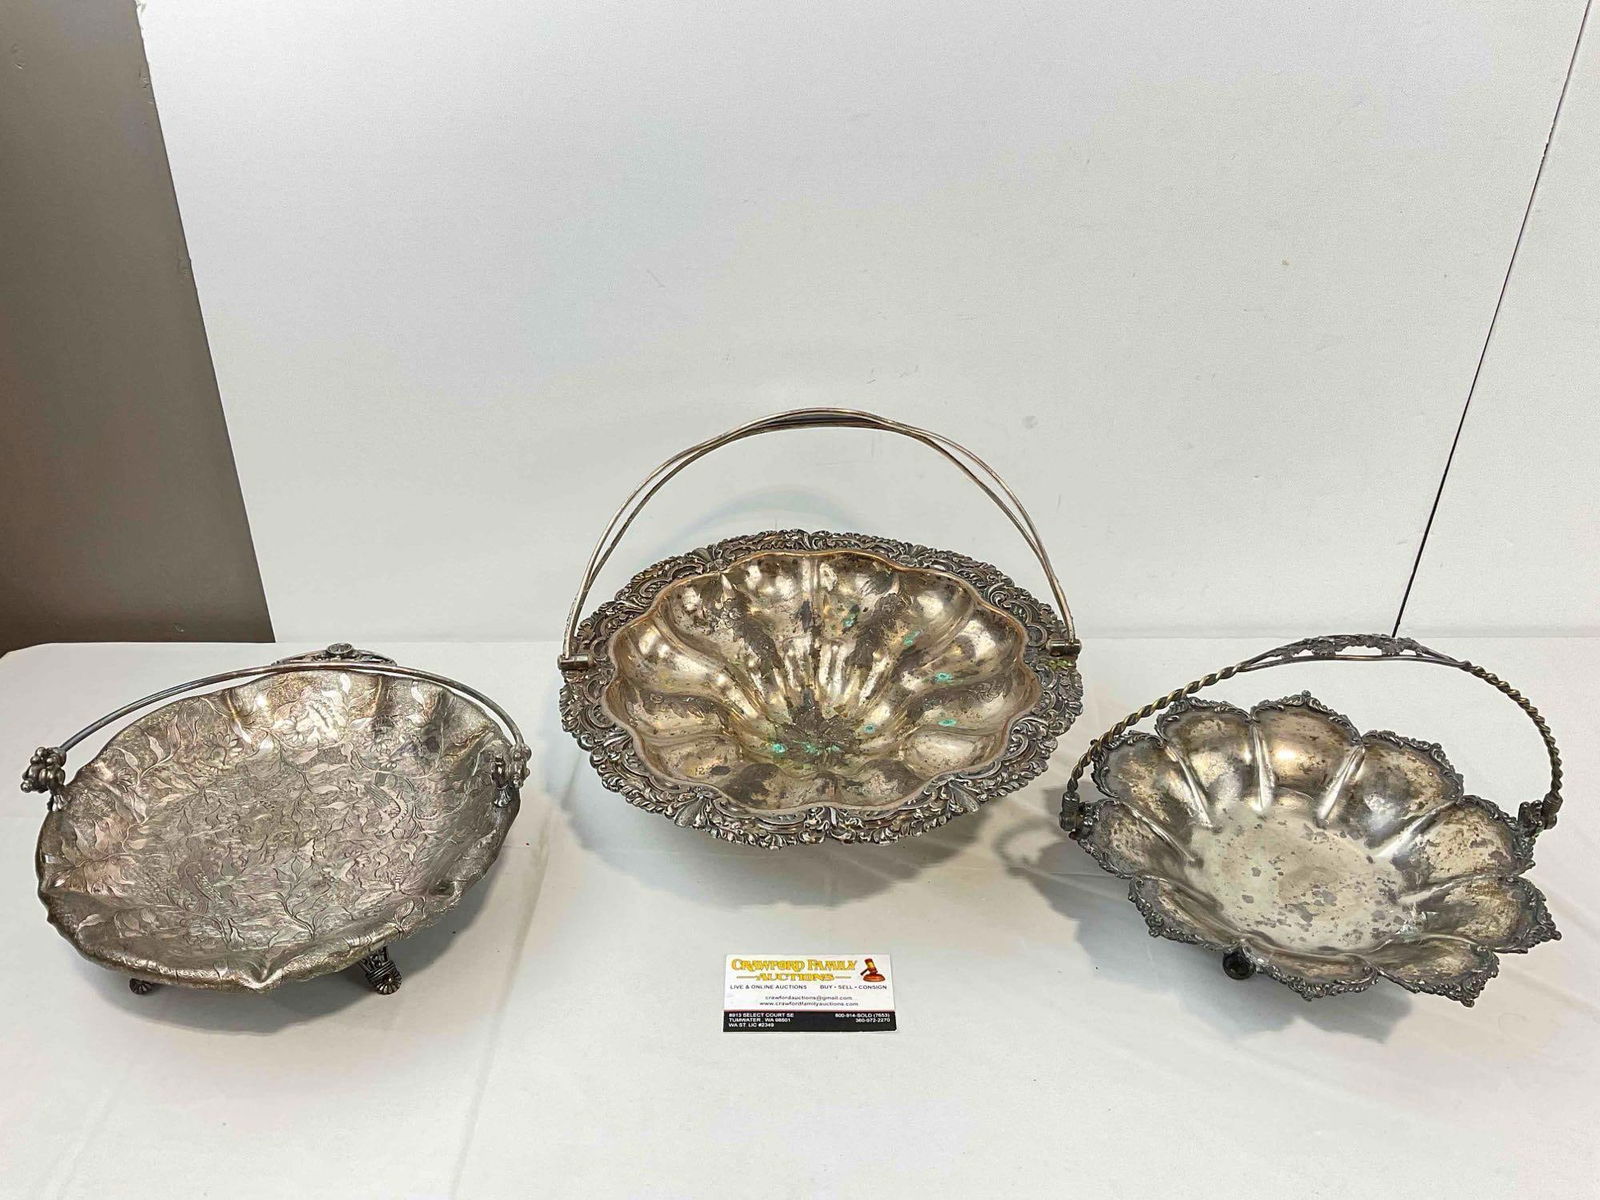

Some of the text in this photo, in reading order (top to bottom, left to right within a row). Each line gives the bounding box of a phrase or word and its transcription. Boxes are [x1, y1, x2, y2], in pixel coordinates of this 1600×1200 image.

[731, 958, 857, 972] CRAWFORD FAMILY
[757, 972, 835, 981] AUCTIONS
